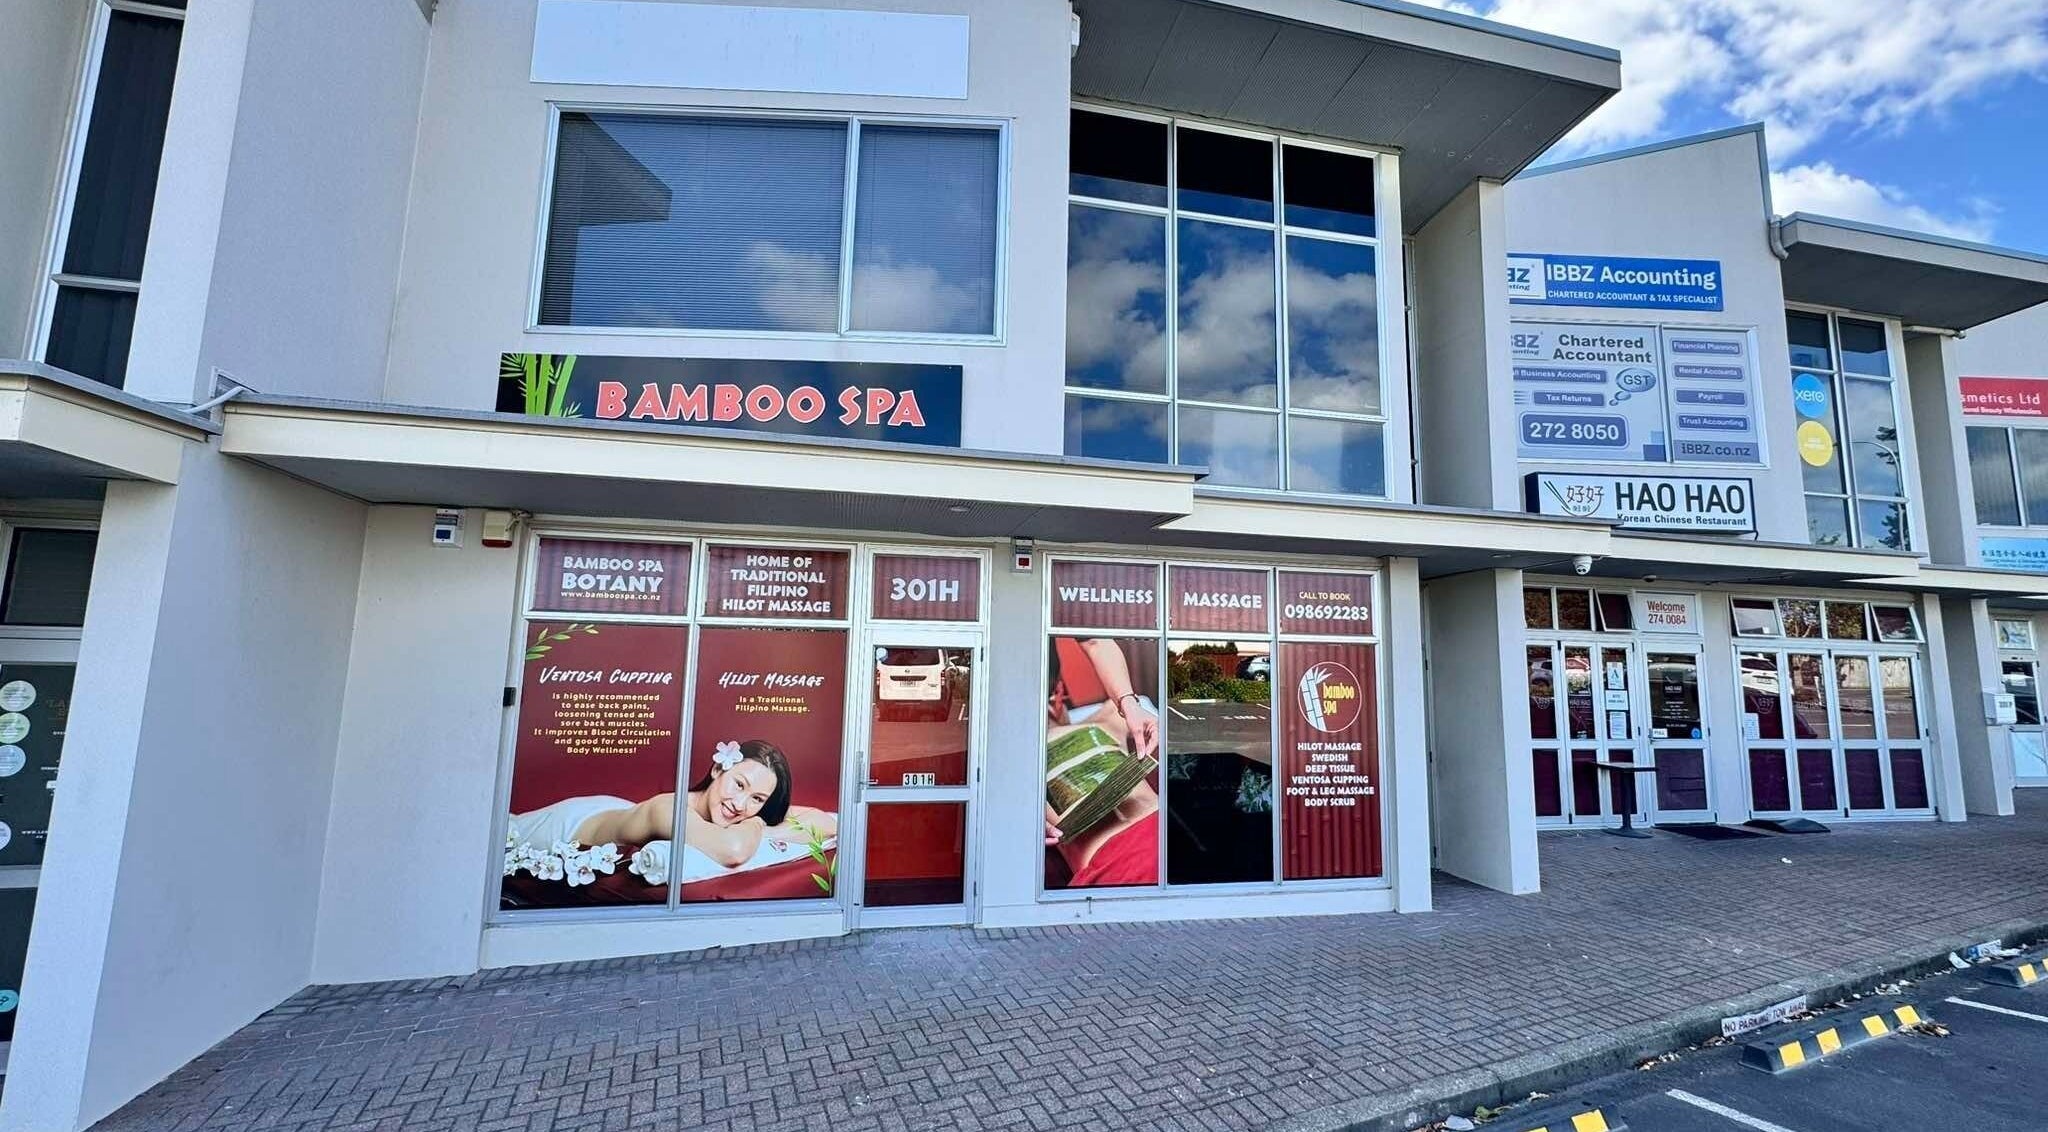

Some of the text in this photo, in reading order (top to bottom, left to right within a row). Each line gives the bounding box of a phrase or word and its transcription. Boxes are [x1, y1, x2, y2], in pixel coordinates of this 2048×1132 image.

[1546, 264, 1716, 291] IBBZ Accounting
[1548, 290, 1594, 300] CHARTERED
[1596, 292, 1648, 301] ACCOUNTANT
[1673, 295, 1718, 304] SPECIALIST
[1559, 334, 1644, 349] Chartered
[1674, 342, 1706, 350] Financial
[1553, 348, 1652, 363] Accountant
[1520, 368, 1555, 377] Business
[1556, 371, 1601, 380] Accounting
[1704, 368, 1737, 376] Accounts
[1623, 374, 1651, 386] GST
[1561, 394, 1592, 402] Returns
[1698, 392, 1724, 401] Payroll
[1794, 389, 1824, 402] xero
[2019, 392, 2040, 405] Ltd
[595, 381, 926, 427] BAMBOO SPA
[1682, 417, 1744, 428] Trust Accounting
[1530, 422, 1619, 440] 272 8050
[1681, 443, 1751, 456] iBBZ.co.nz
[1566, 485, 1604, 504] 好好
[1615, 481, 1745, 514] HAO HAO
[1617, 514, 1747, 526] Korean Chinese Restaurant
[563, 556, 664, 572] BAMBOO SPA
[746, 555, 812, 568] HOME OF
[730, 569, 826, 583] TRADITIONAL
[562, 573, 664, 592] BOTANY
[561, 591, 661, 600] www.bamboospa.co.nz
[747, 585, 808, 597] FILIPINO
[890, 578, 959, 602] 301H
[1059, 586, 1153, 605] WELLNESS
[1299, 591, 1351, 601] CALL TO BOOK
[722, 599, 831, 613] HILOT MASSAGE
[1183, 592, 1262, 609] MASSAGE
[1647, 600, 1686, 612] Welcome
[1284, 604, 1368, 620] 098692283
[1648, 614, 1664, 624] 274
[1323, 682, 1355, 699] bamboo
[563, 693, 593, 701] highly
[596, 693, 659, 701] recommended
[623, 703, 650, 711] pains,
[735, 704, 811, 713] Filipino Massage.
[1323, 700, 1337, 715] spa
[554, 711, 601, 719] loosening
[534, 728, 542, 736] It
[575, 738, 598, 746] good
[1297, 742, 1362, 751] HILOT MASSAGE
[1312, 754, 1348, 762] SWEDISH
[1305, 764, 1355, 773] DEEP TISSUE
[904, 774, 934, 785] 301H
[1291, 775, 1369, 784] VENTOSA CUPPING
[1286, 787, 1375, 796] FOOT & LEG MASSAGE
[1304, 798, 1355, 807] BODY SCRUB
[1724, 1021, 1736, 1032] NO
